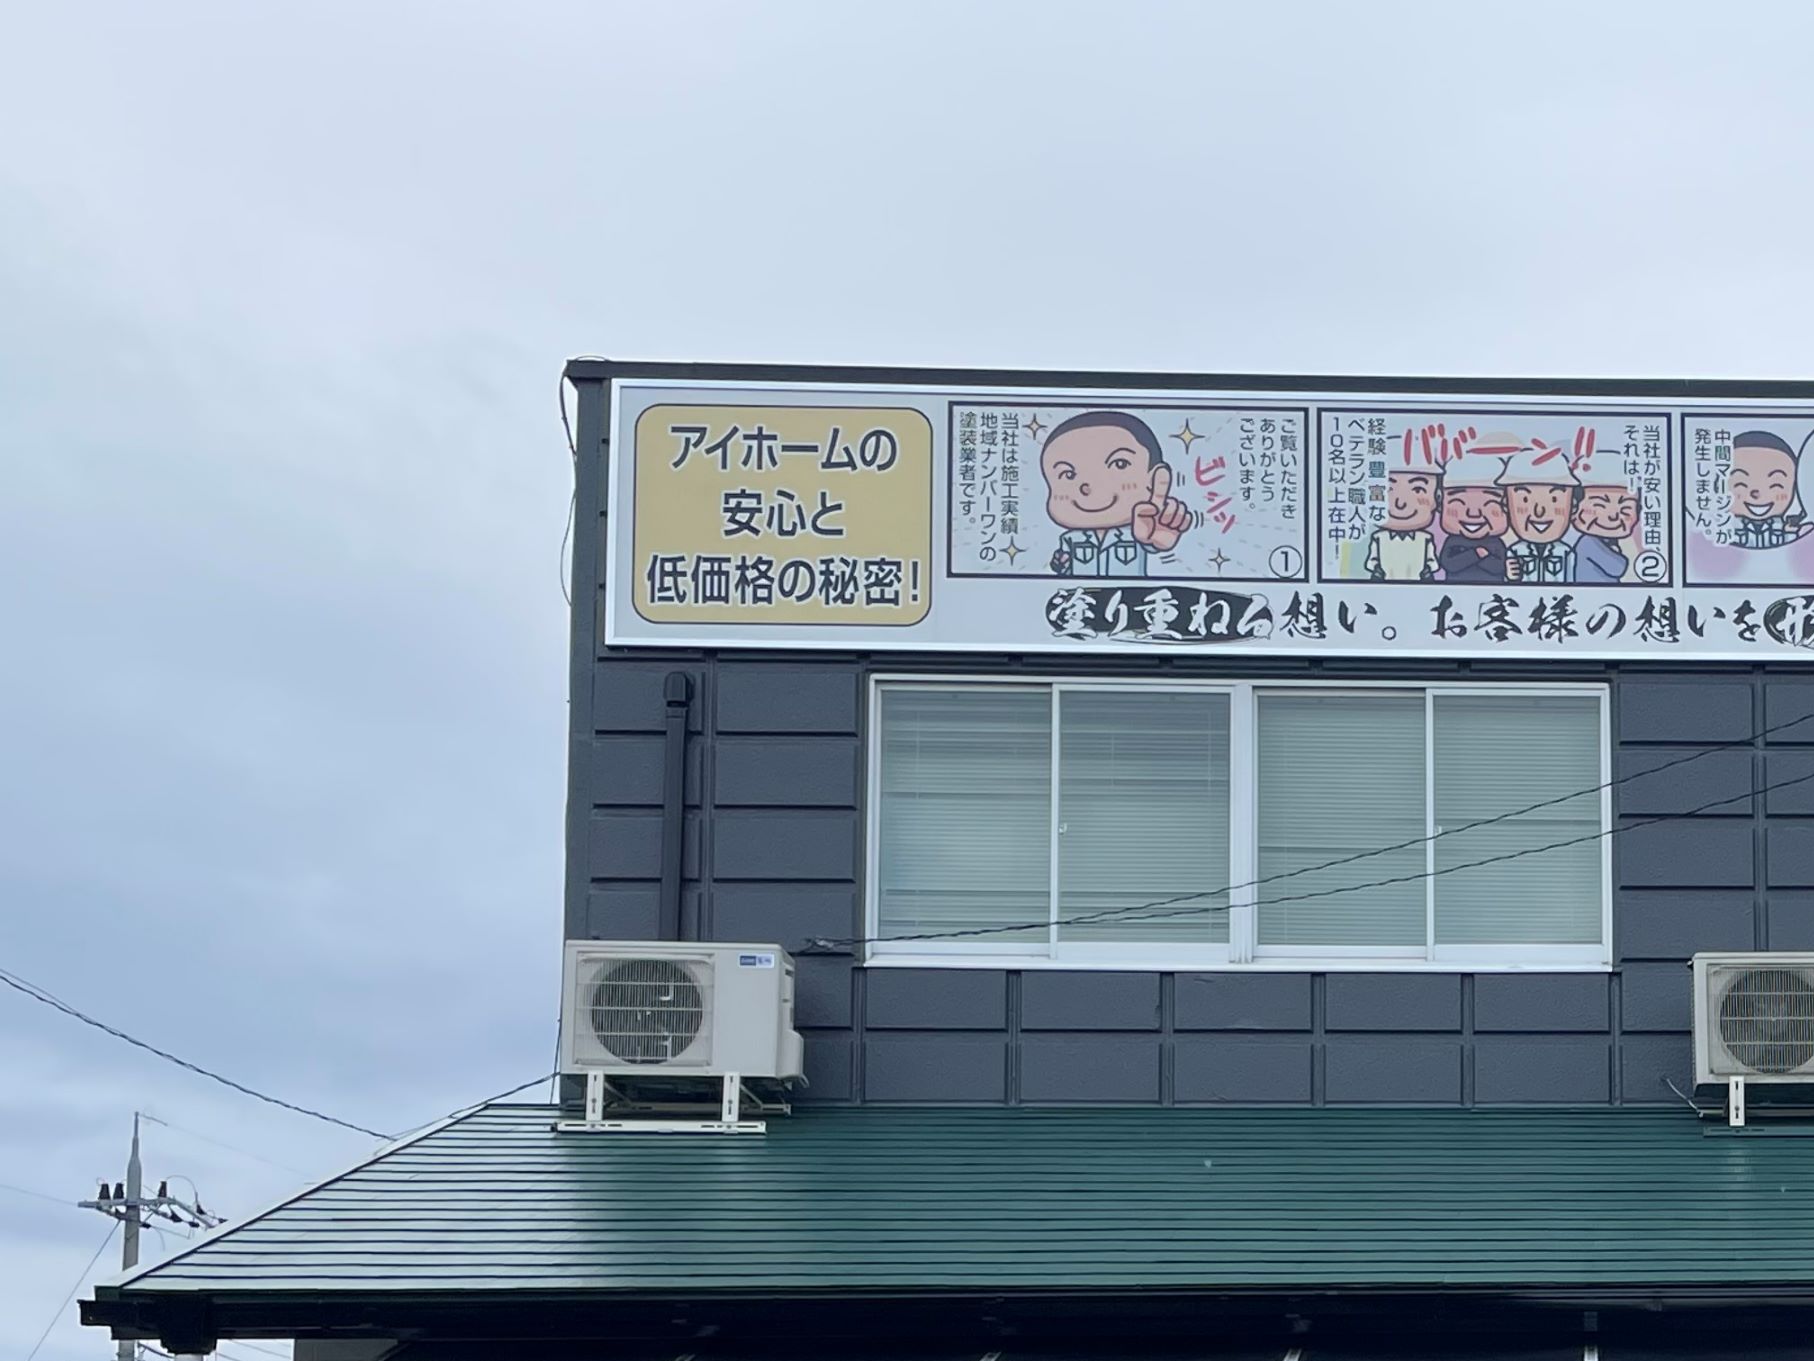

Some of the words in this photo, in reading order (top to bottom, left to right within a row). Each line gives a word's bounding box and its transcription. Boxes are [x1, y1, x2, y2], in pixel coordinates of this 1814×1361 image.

[670, 425, 898, 471] アイホームの
[959, 411, 977, 525] 塗装業者です。
[980, 413, 998, 562] 地域ナンバーワンの
[1001, 413, 1019, 535] 当社は施工実績
[1239, 417, 1256, 511] ございます。
[1260, 418, 1276, 502] ありがとう
[1280, 418, 1298, 519] ご覧いただき
[1348, 418, 1366, 540] ベテラン職人が
[1367, 418, 1386, 522] 経験豊富な
[1694, 428, 1712, 535] 発生しません。
[1714, 428, 1732, 545] 中間マージンが
[722, 488, 844, 537] 安心と
[646, 554, 919, 606] 低価格の秘密！
